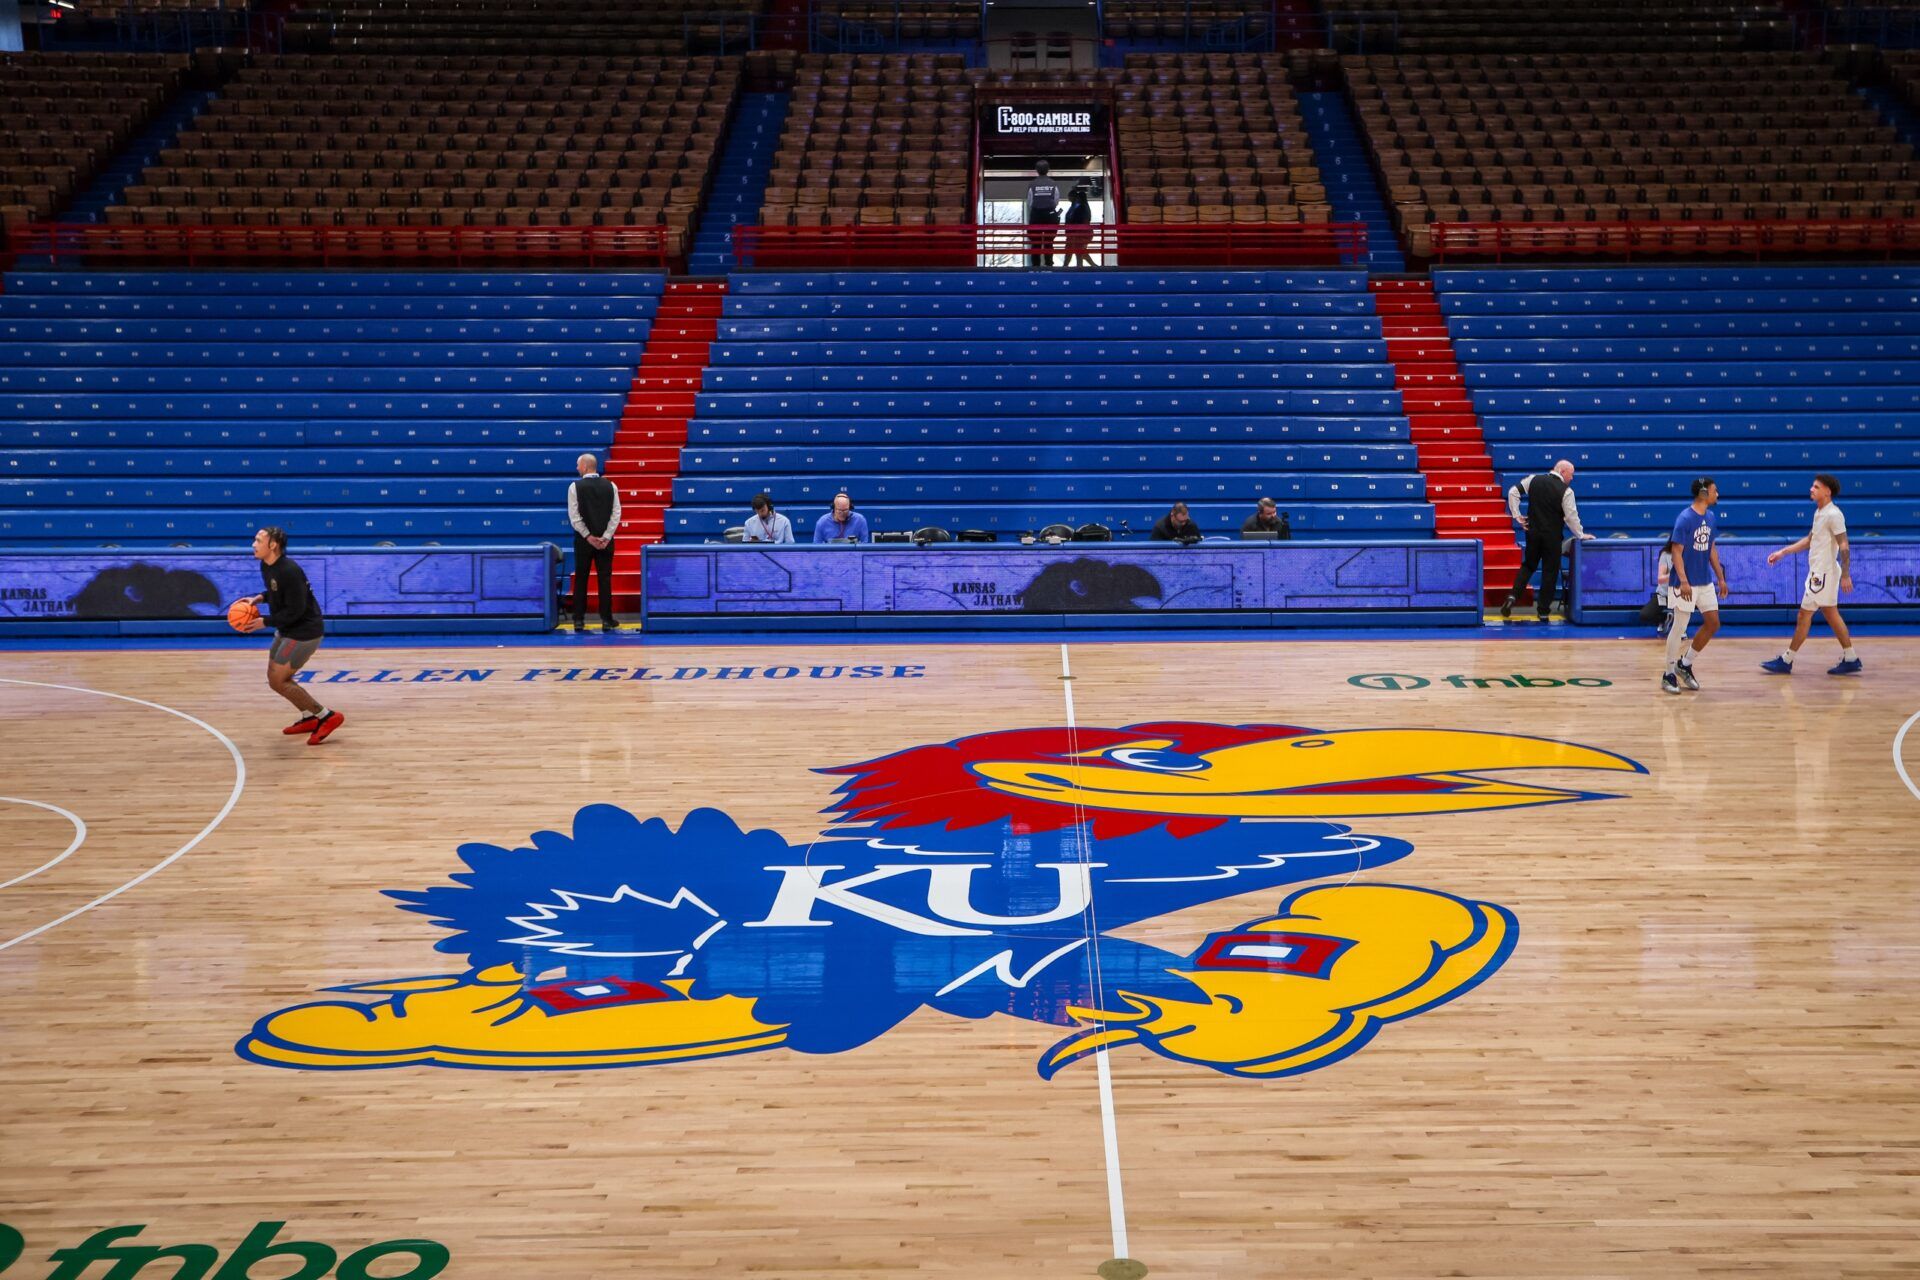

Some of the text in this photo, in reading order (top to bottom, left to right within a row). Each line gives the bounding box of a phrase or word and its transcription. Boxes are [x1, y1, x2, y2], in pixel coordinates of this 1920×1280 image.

[1002, 112, 1091, 126] 1-800-GAMBLER
[730, 213, 737, 222] 3
[724, 233, 731, 242] 2
[952, 582, 996, 594] KANSAS
[1885, 575, 1920, 588] KANSA
[1, 588, 47, 600] KANSAS
[291, 665, 926, 683] ALLEN FIELDHOUSE
[1441, 674, 1613, 689] fnbo
[743, 862, 1109, 937] KU
[47, 1221, 451, 1280] fnbo
